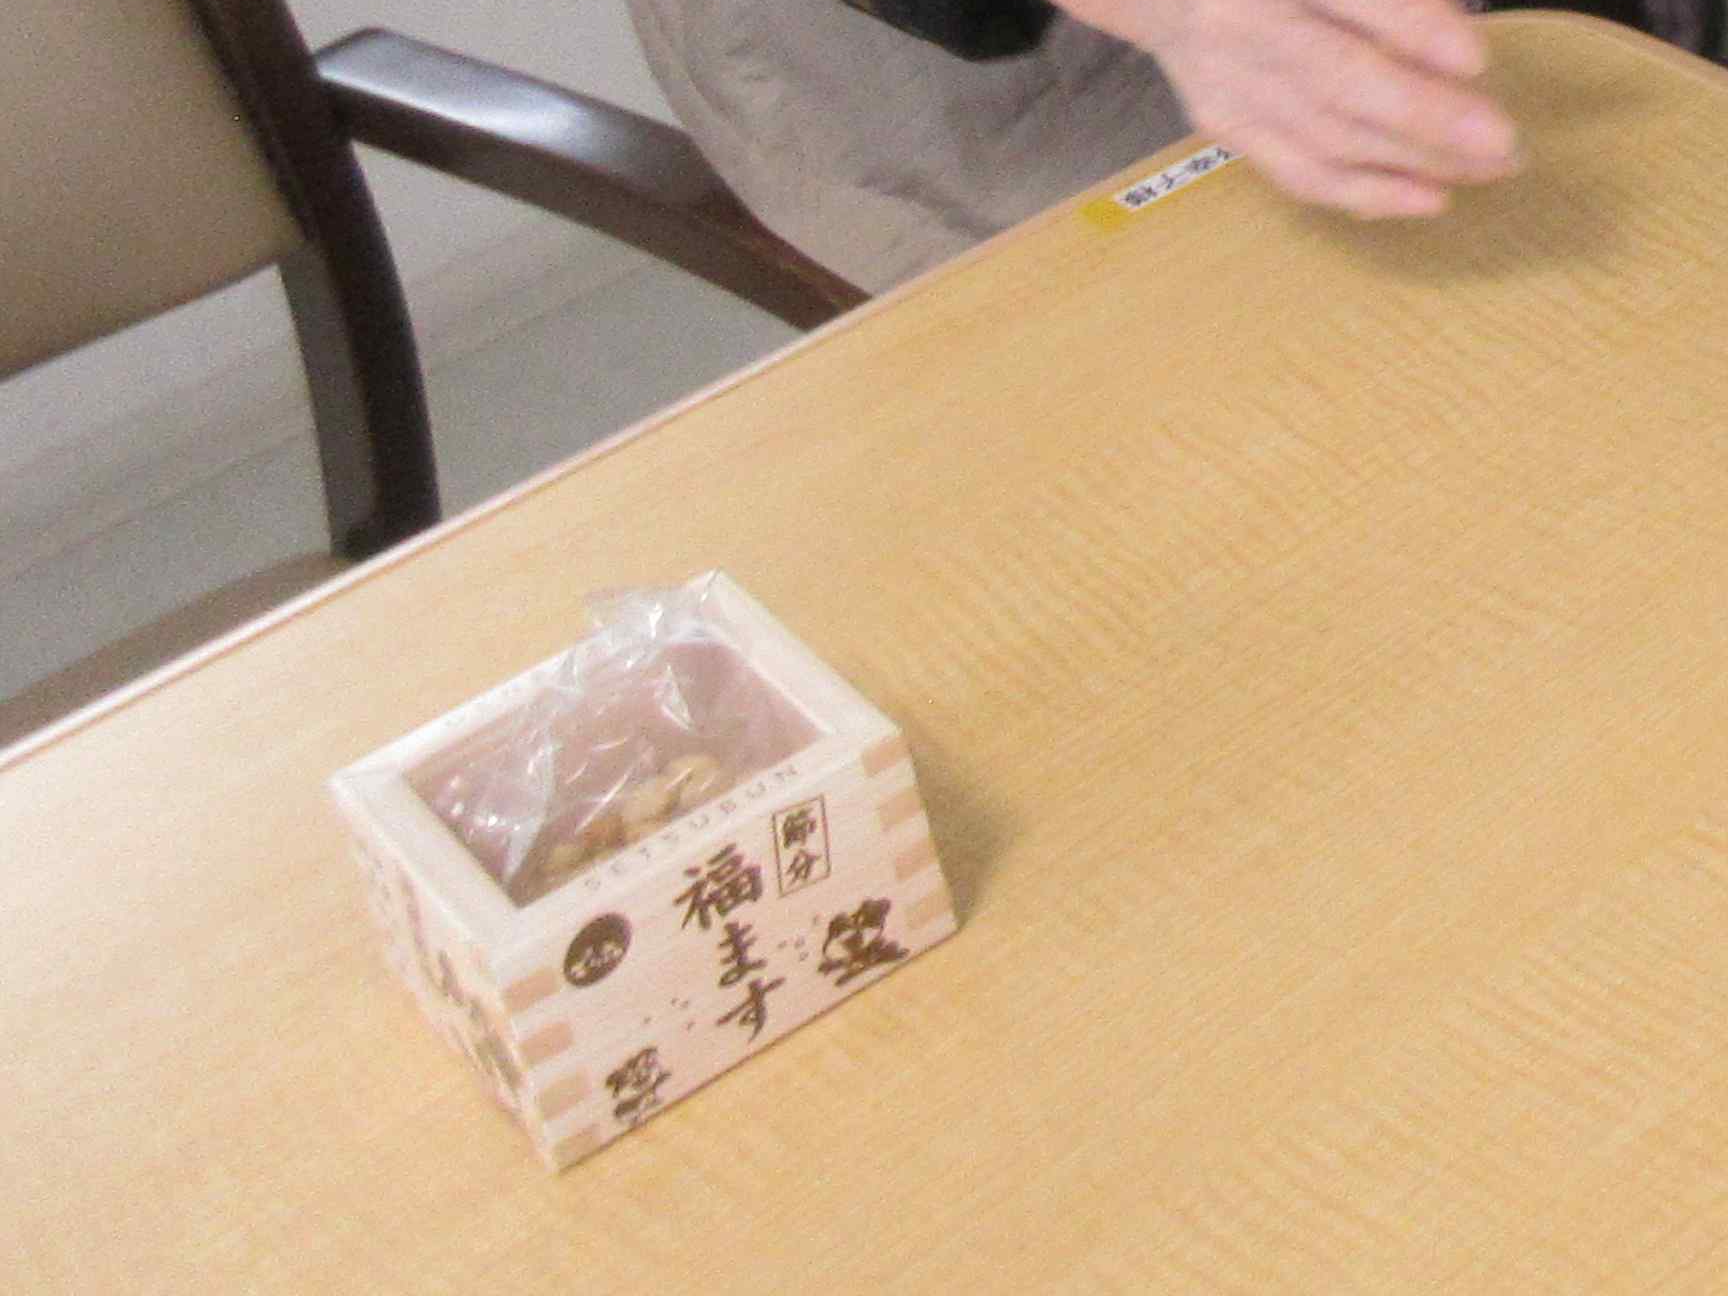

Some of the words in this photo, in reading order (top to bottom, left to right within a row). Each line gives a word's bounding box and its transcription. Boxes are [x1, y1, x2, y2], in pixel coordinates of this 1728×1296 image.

[584, 764, 798, 892] SETSUBUN
[781, 808, 821, 886] 節分
[673, 843, 786, 1042] 福ます
